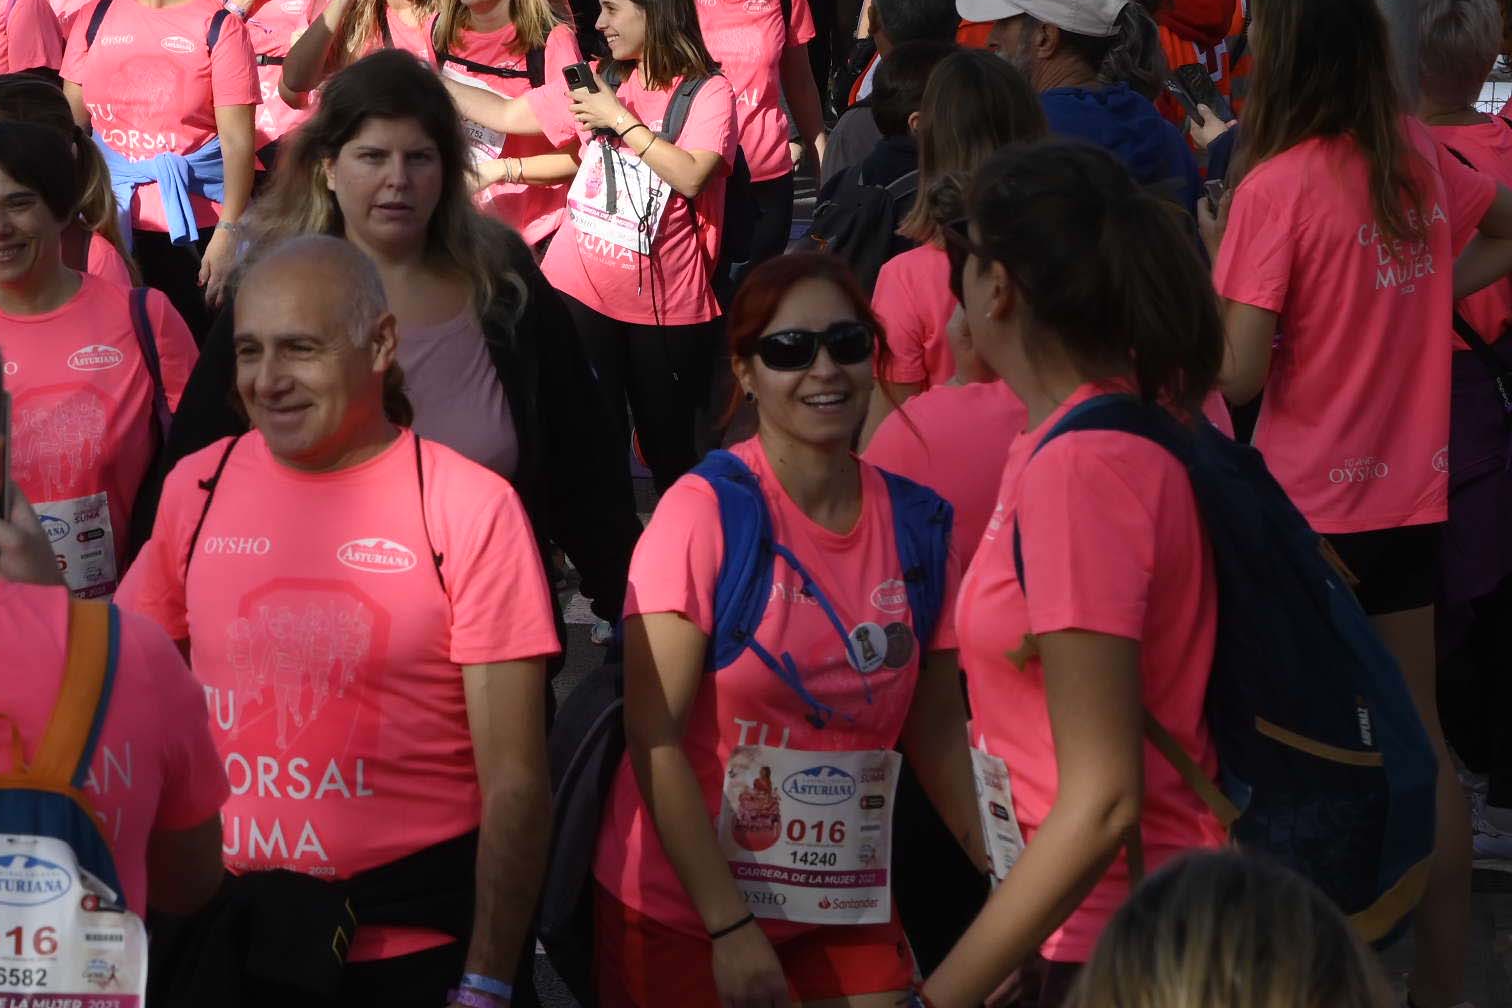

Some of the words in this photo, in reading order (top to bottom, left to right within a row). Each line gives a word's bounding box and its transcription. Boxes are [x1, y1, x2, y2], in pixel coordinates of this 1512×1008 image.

[203, 536, 272, 556] OYSHO
[343, 546, 411, 569] ASTURIANA
[788, 778, 854, 796] ASTURIANA
[786, 819, 846, 843] 016
[790, 850, 837, 867] 14240
[737, 864, 788, 880] CARRERA
[790, 872, 809, 883] DE
[808, 873, 823, 883] LA
[824, 874, 857, 884] MUJER
[831, 896, 879, 911] Santander
